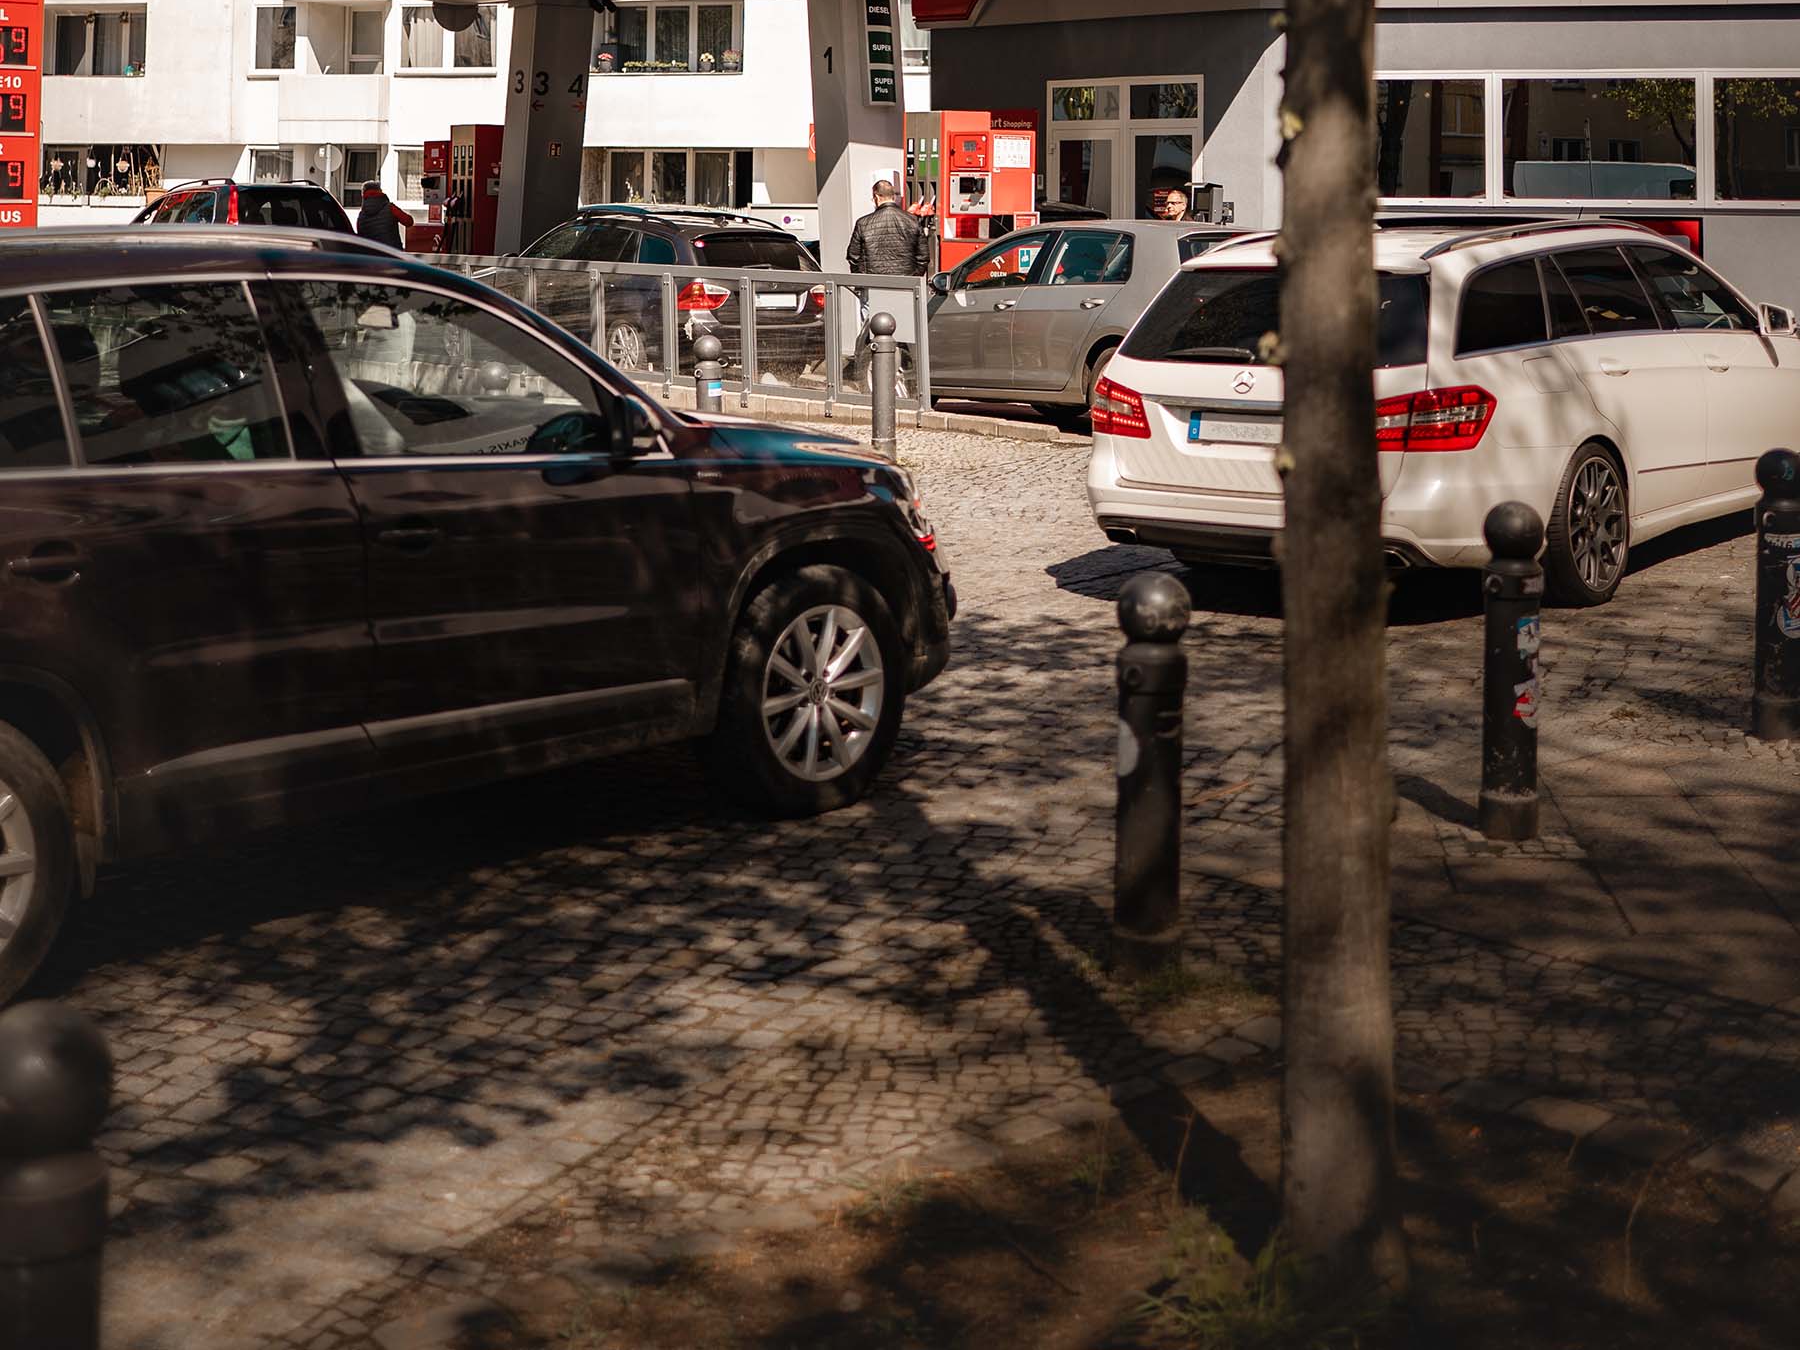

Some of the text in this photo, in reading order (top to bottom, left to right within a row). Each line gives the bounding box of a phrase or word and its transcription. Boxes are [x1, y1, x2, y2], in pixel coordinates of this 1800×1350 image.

[868, 5, 890, 15] DIESEL
[872, 43, 891, 52] SUPER
[823, 46, 833, 74] 1
[514, 70, 525, 94] 3
[533, 71, 584, 98] 3 4
[874, 77, 893, 85] SUPER
[874, 86, 889, 94] Plus
